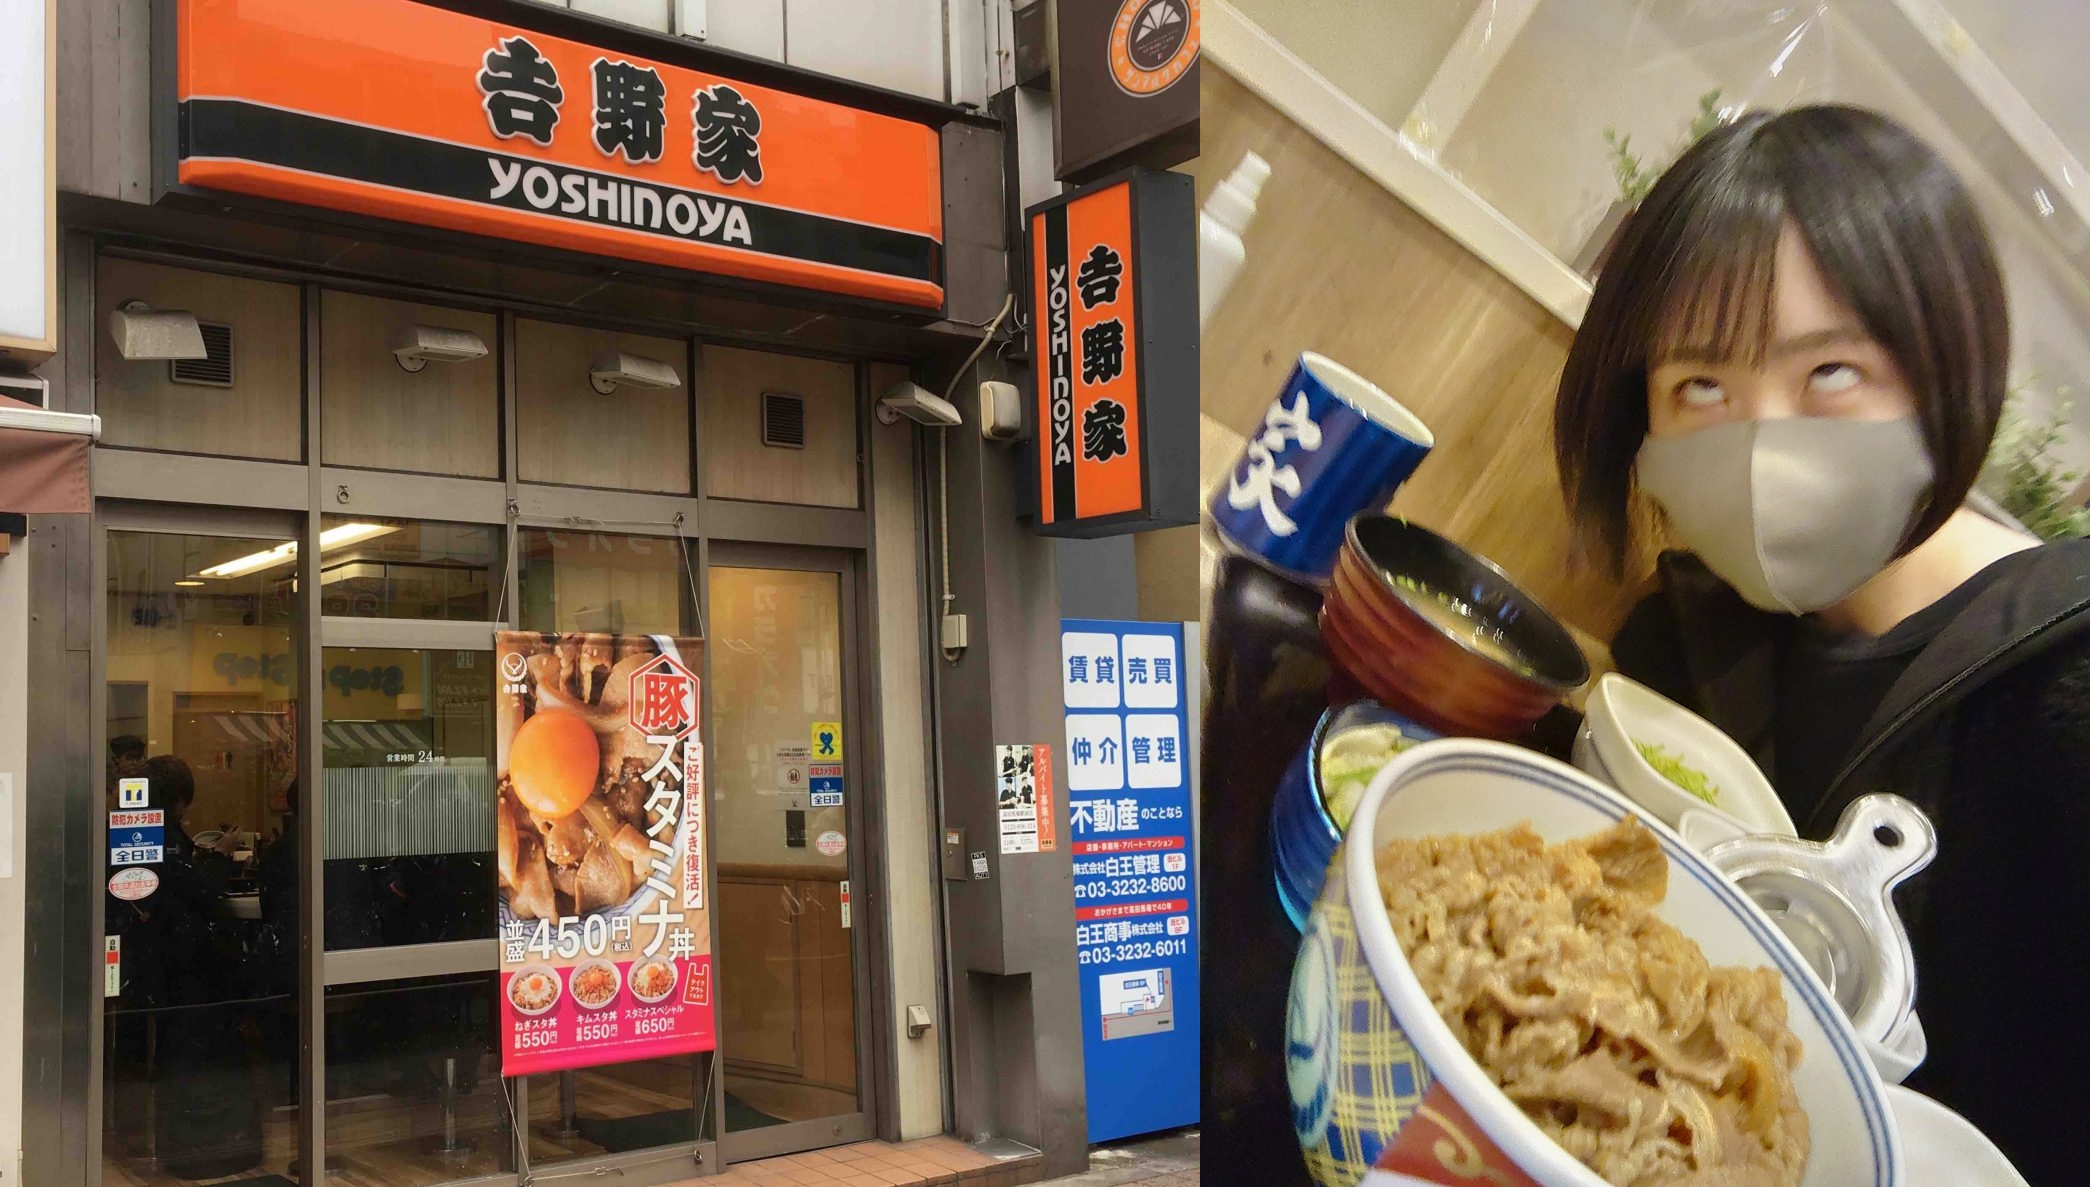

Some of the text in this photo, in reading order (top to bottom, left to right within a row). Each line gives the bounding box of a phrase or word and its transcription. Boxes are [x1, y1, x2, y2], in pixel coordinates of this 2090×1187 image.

[475, 35, 765, 186] 吉野家
[487, 157, 753, 246] YOSHINOYA
[1048, 264, 1073, 467] YOSHINOYA
[1076, 243, 1128, 464] 吉野家
[1068, 655, 1115, 684] 賃貸
[1128, 657, 1172, 684] 売買
[641, 673, 689, 729] 豚
[386, 753, 415, 763] 営業時間
[1071, 737, 1118, 765] 仲介
[1131, 736, 1176, 764] 管理
[111, 812, 162, 826] 防犯カメラ設置
[116, 848, 158, 863] 全日警
[1087, 875, 1186, 899] 03-3232-8600
[1092, 938, 1186, 964] 03-3232-6011
